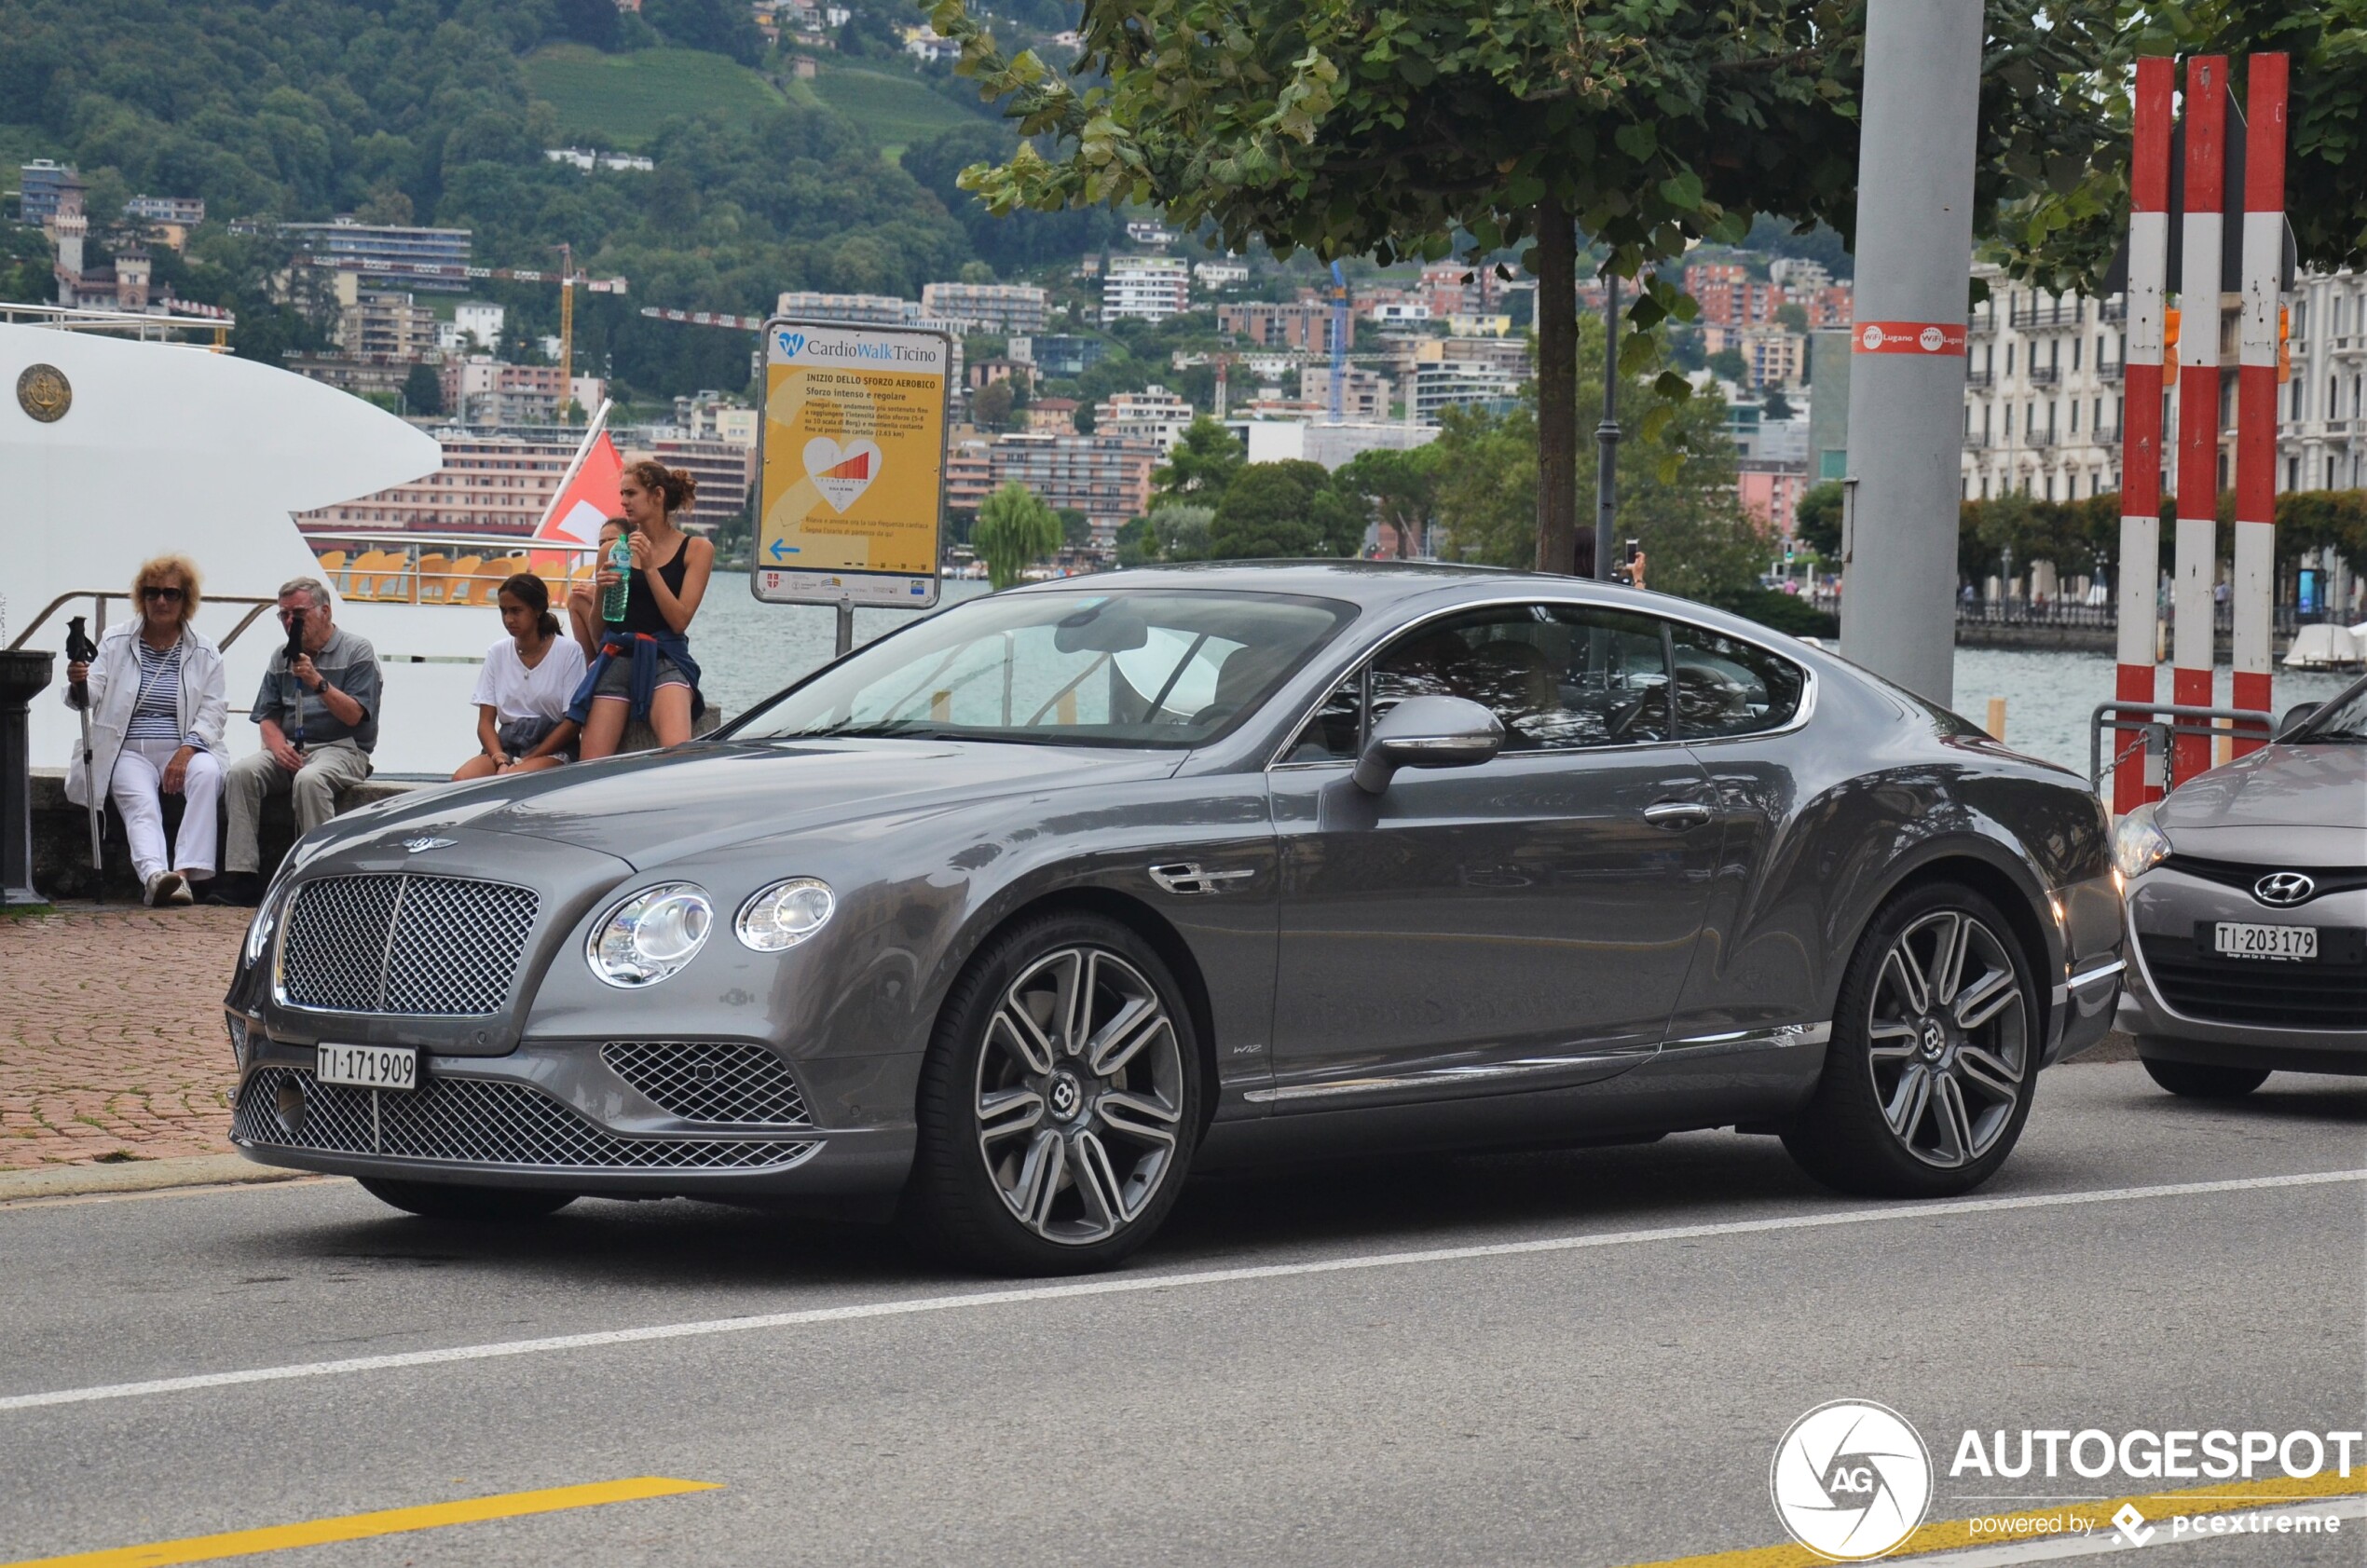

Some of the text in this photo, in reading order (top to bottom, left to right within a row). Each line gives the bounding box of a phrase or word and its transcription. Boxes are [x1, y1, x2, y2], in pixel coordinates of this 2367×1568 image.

[1882, 334, 1913, 343] Lugano
[1922, 334, 1942, 343] WiFi
[806, 374, 936, 389] INIZIO DELLO SFORZO AEROBICO
[806, 387, 831, 396] Sforzo
[834, 389, 864, 399] intenso
[874, 391, 906, 402] regolare
[805, 401, 830, 409] Prosegui
[810, 410, 844, 418] raggiungere
[845, 419, 861, 428] Borg)
[652, 428, 700, 440] EDEN
[1233, 1044, 1262, 1054] W12
